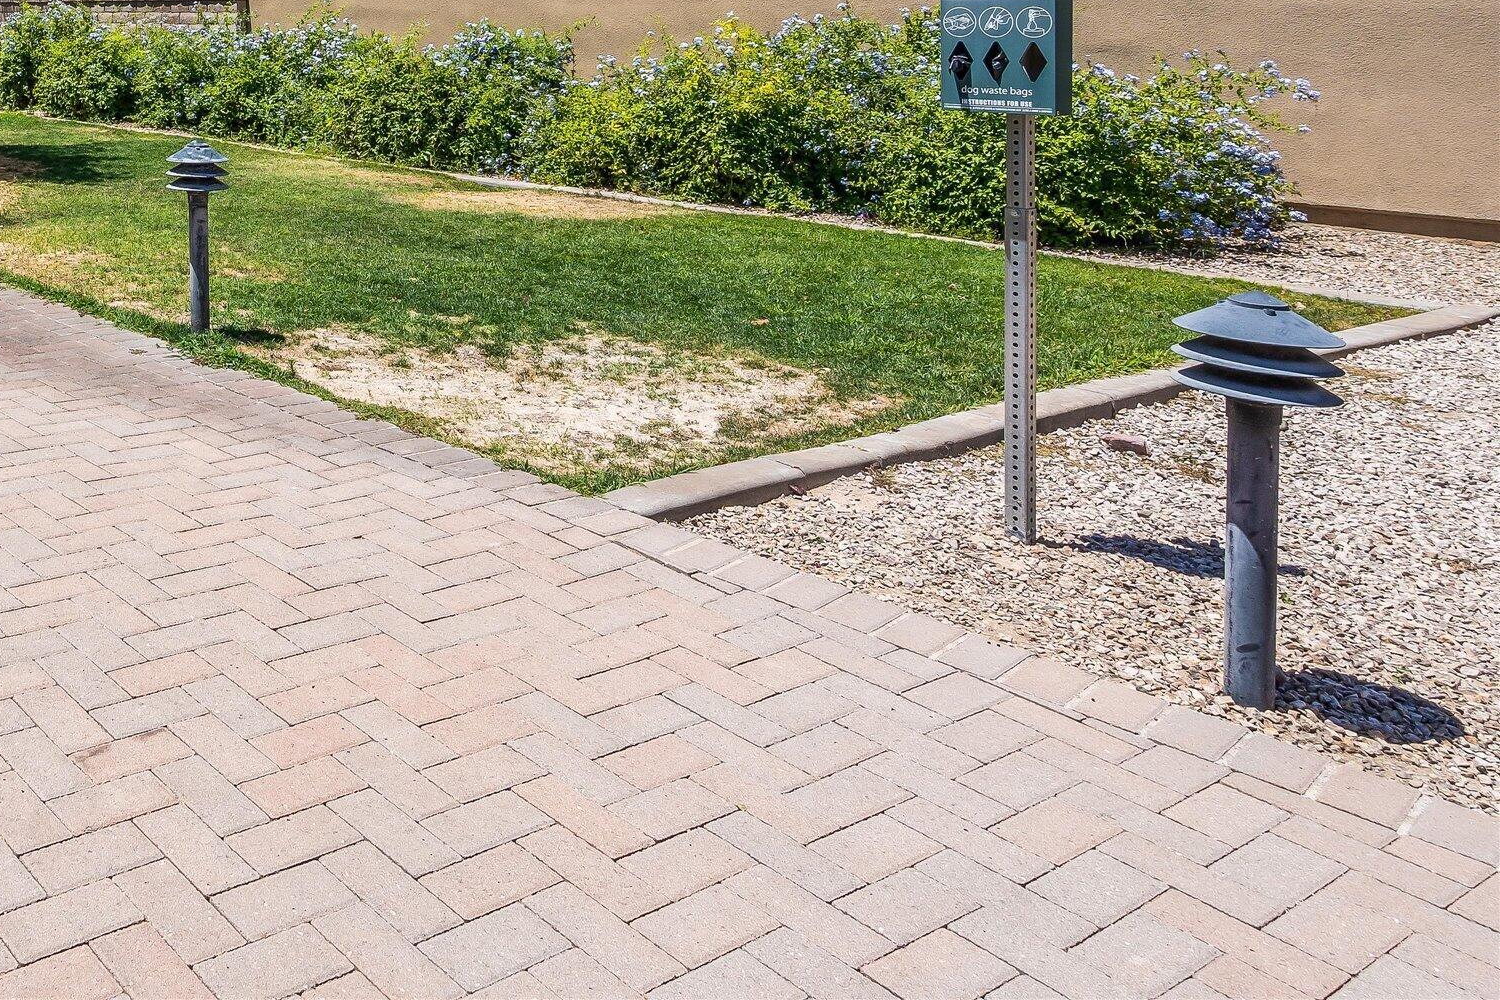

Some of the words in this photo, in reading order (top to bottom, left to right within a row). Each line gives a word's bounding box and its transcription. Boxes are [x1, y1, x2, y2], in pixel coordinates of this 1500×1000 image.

[961, 85, 979, 95] dog
[981, 86, 1008, 95] waste
[1009, 86, 1033, 97] bags
[961, 98, 1006, 107] INSTRUCTIONS
